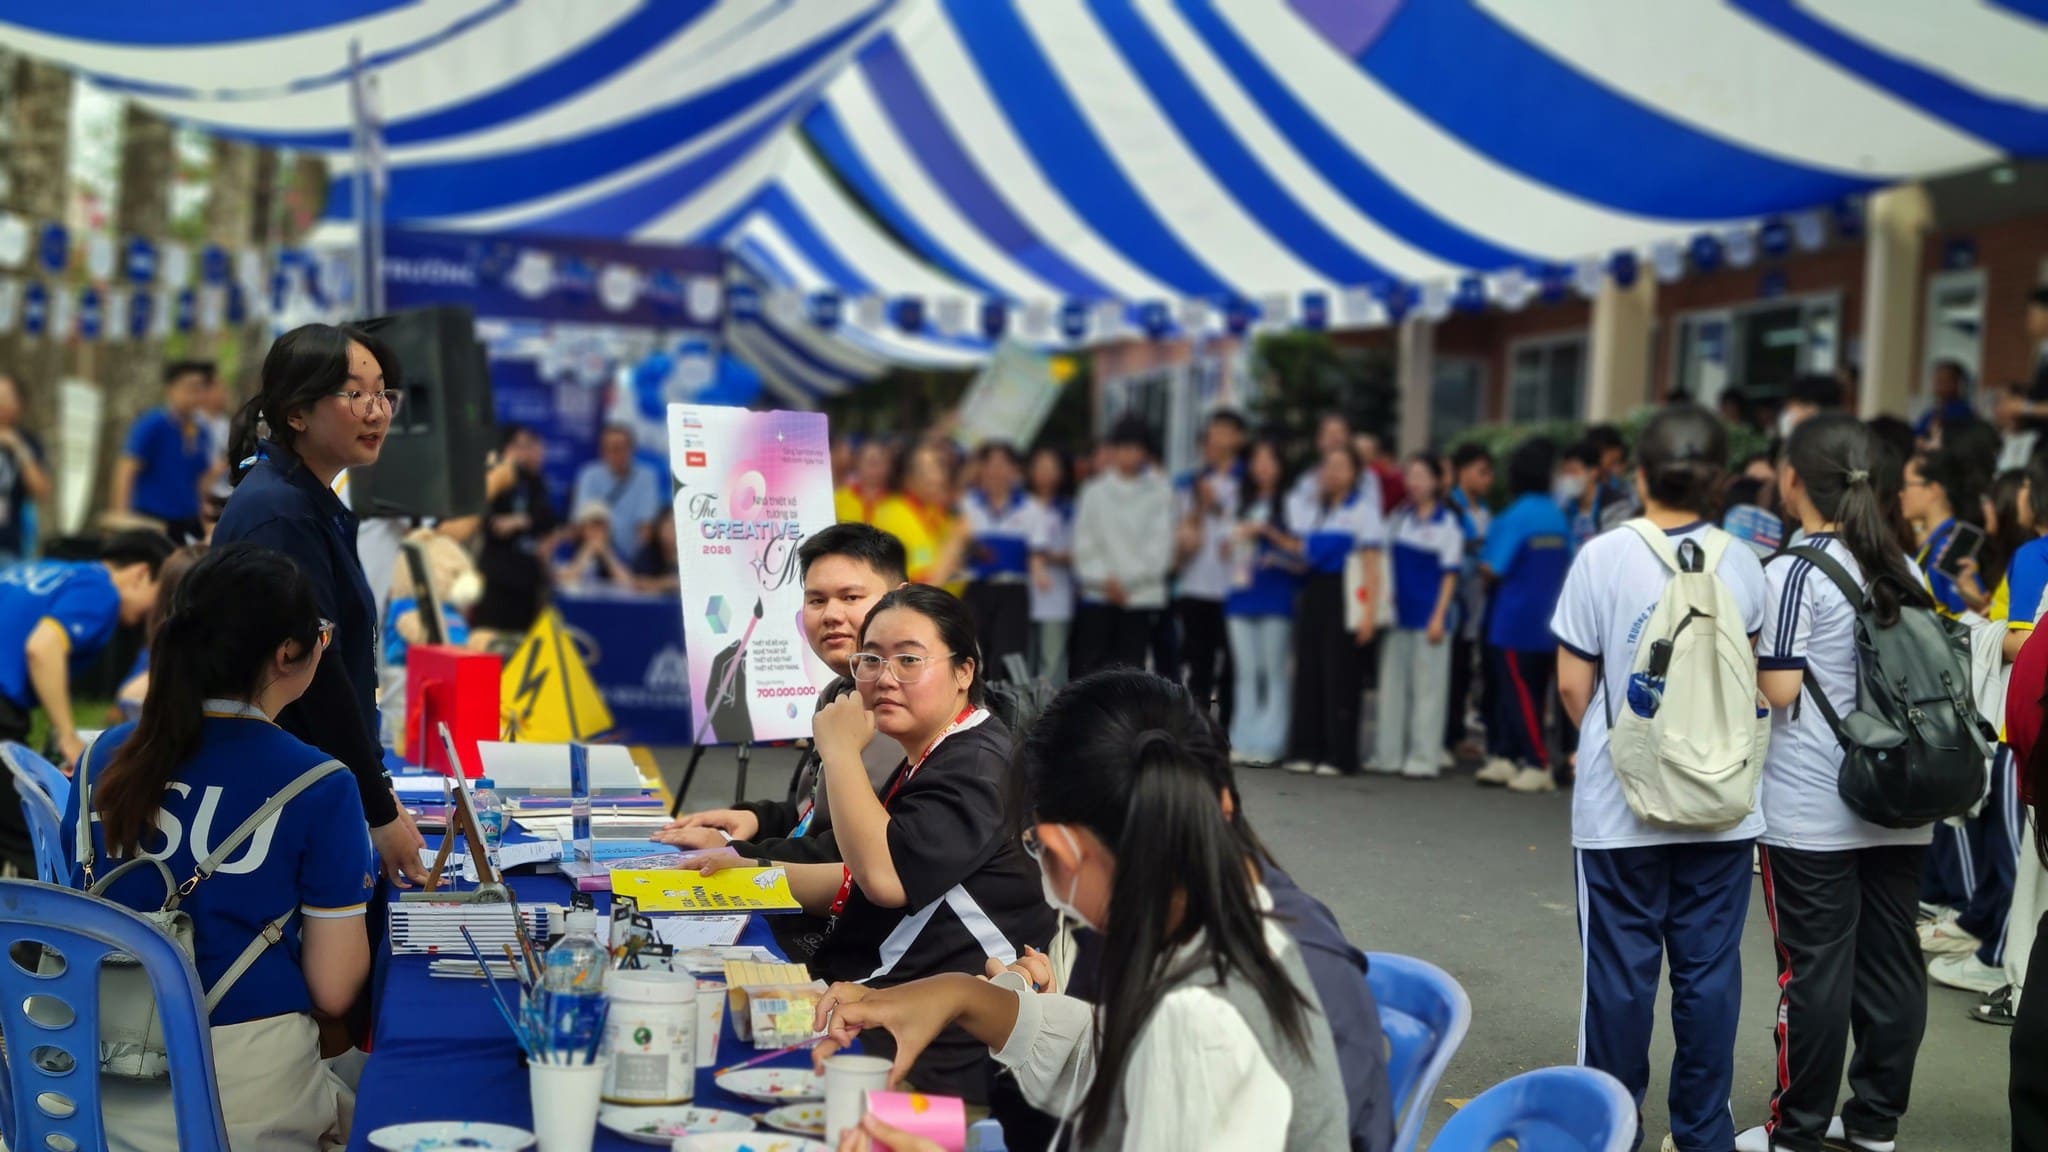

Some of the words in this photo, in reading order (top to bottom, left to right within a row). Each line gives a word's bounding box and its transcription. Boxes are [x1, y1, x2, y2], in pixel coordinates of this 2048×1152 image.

[689, 493, 718, 520] The
[701, 520, 800, 540] CREATIVE
[702, 545, 732, 555] 2026
[757, 686, 816, 699] 700.000.000
